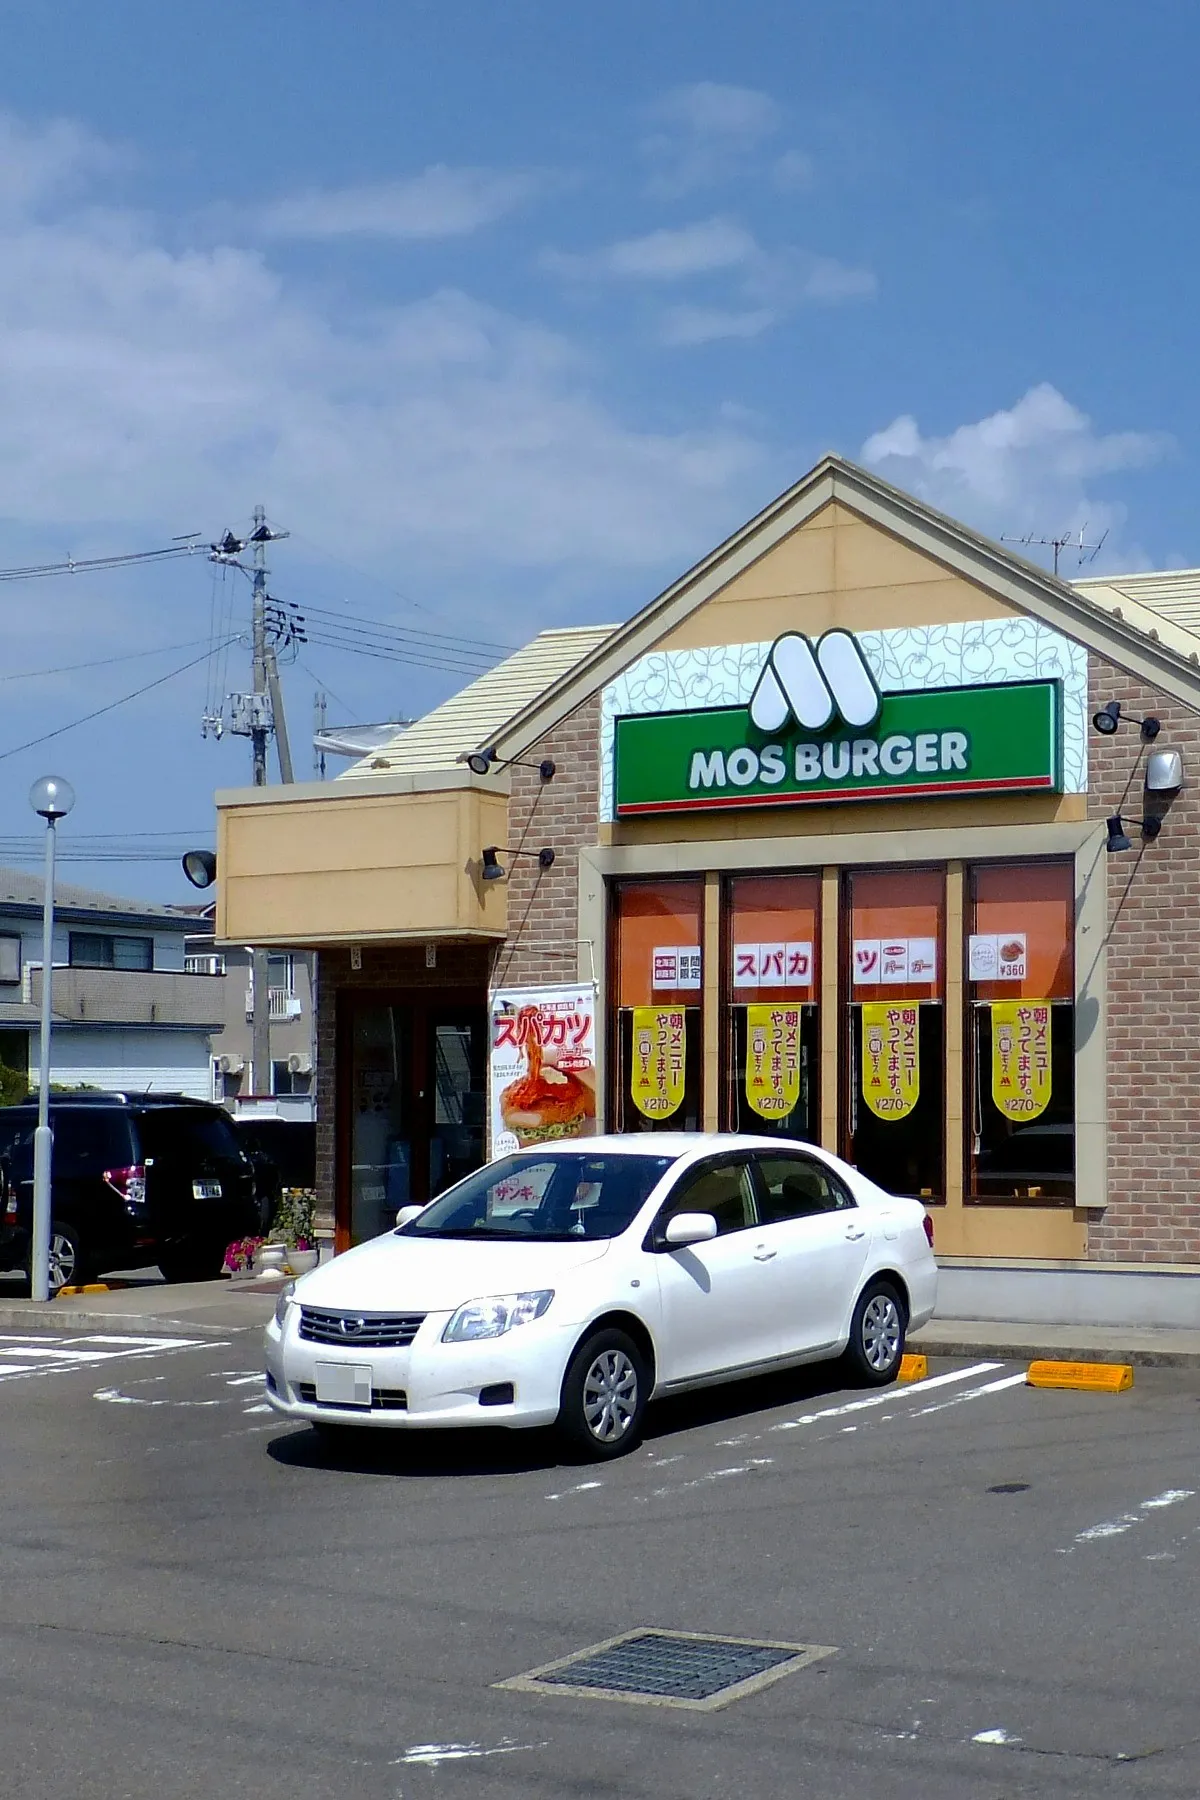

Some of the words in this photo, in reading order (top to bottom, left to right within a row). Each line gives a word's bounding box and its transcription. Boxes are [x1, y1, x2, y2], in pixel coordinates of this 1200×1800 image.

[689, 745, 786, 788] MOS
[795, 732, 967, 781] BURGER
[737, 950, 809, 977] スパカ
[1000, 964, 1024, 976] ¥360
[493, 1013, 591, 1047] スパカツ
[656, 1013, 668, 1095] やってます。
[669, 1013, 683, 1086] 朝メニュー
[770, 1011, 784, 1095] やってます。
[785, 1011, 798, 1085] 朝メニュー
[886, 1009, 902, 1095] やってます。
[902, 1009, 916, 1086] 朝メニュー
[1017, 1007, 1032, 1096] やってます。
[1033, 1007, 1048, 1086] 朝メニュー
